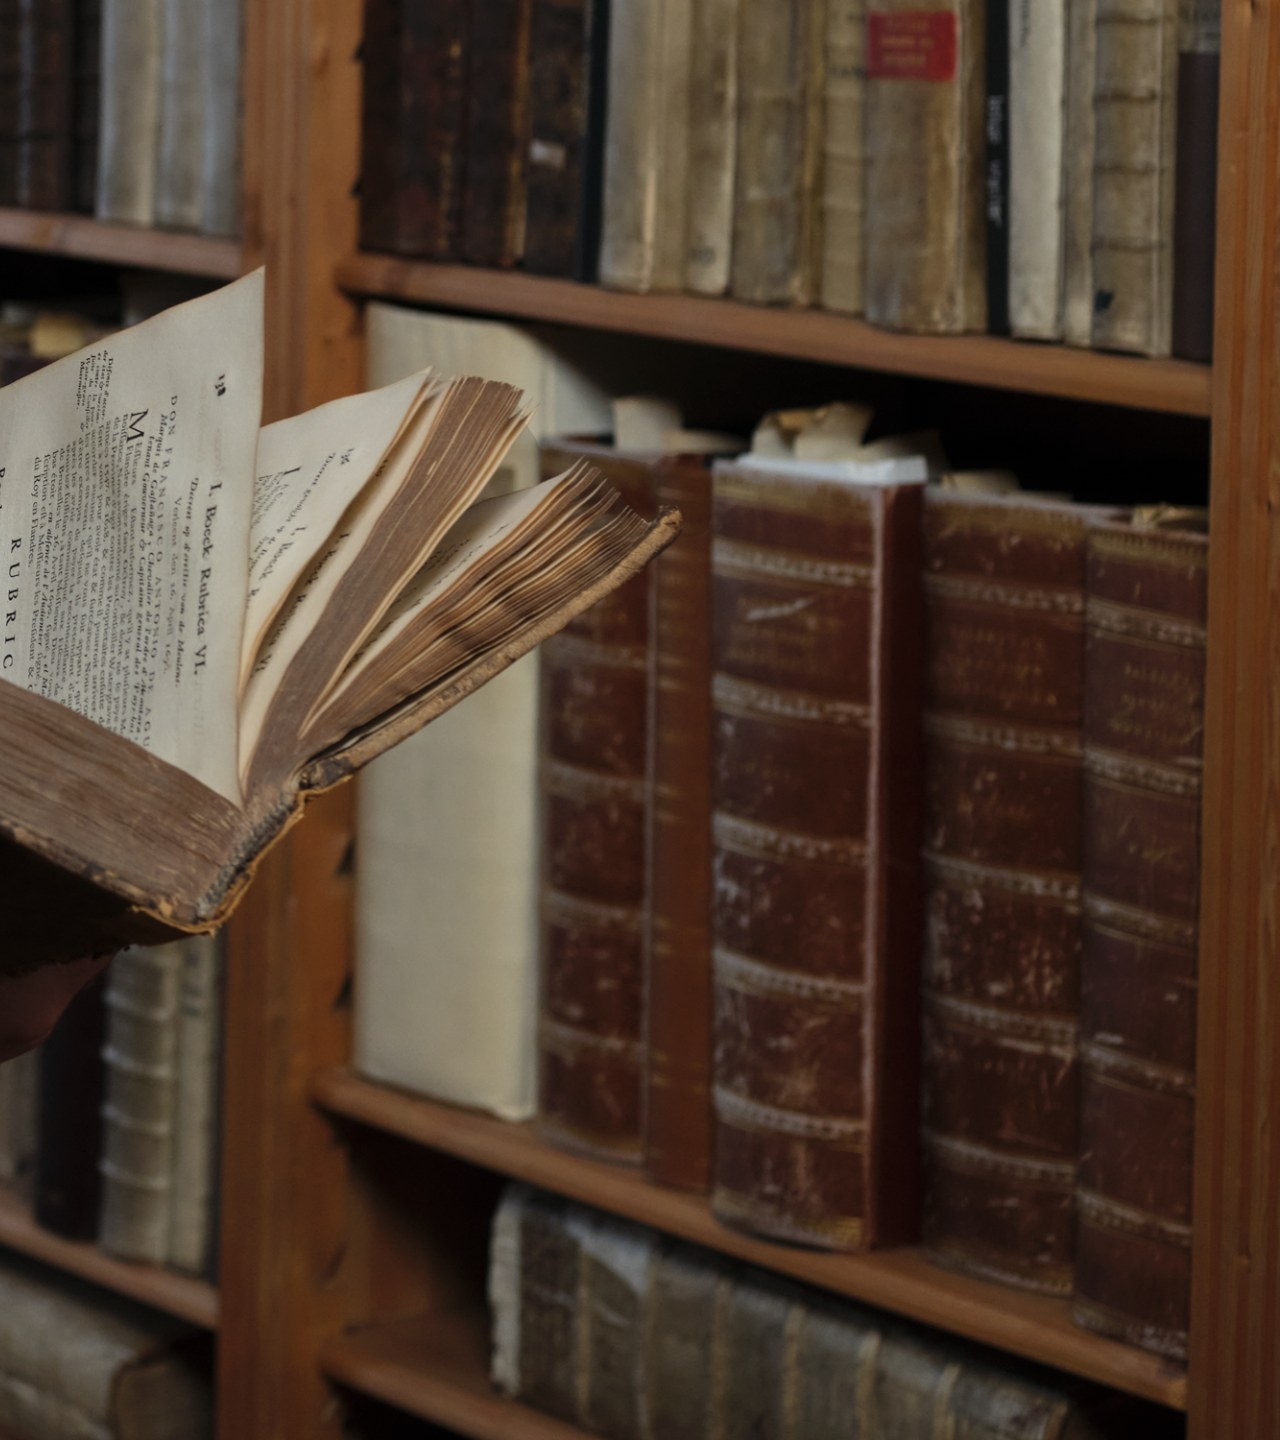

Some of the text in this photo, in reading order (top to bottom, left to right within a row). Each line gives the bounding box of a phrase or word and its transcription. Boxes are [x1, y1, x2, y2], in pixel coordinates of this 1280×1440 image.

[215, 375, 226, 396] 138
[155, 414, 167, 456] Marquis
[168, 395, 178, 435] DON
[109, 446, 117, 498] Province
[124, 445, 134, 487] Flandre
[144, 436, 155, 468] tenant
[31, 475, 41, 497] Roy
[56, 465, 64, 516] Bruxelles
[156, 448, 173, 562] FRANCISCO
[28, 518, 38, 567] Flandres.
[50, 556, 58, 583] Avril
[92, 557, 100, 577] état
[98, 565, 106, 606] comme
[137, 557, 146, 607] Capitaine
[194, 483, 222, 675] I. Boeck Rubrica VI.
[33, 590, 41, 606] les
[151, 577, 162, 658] ANTONIO
[101, 595, 113, 667] Proprietaires
[166, 607, 175, 635] April
